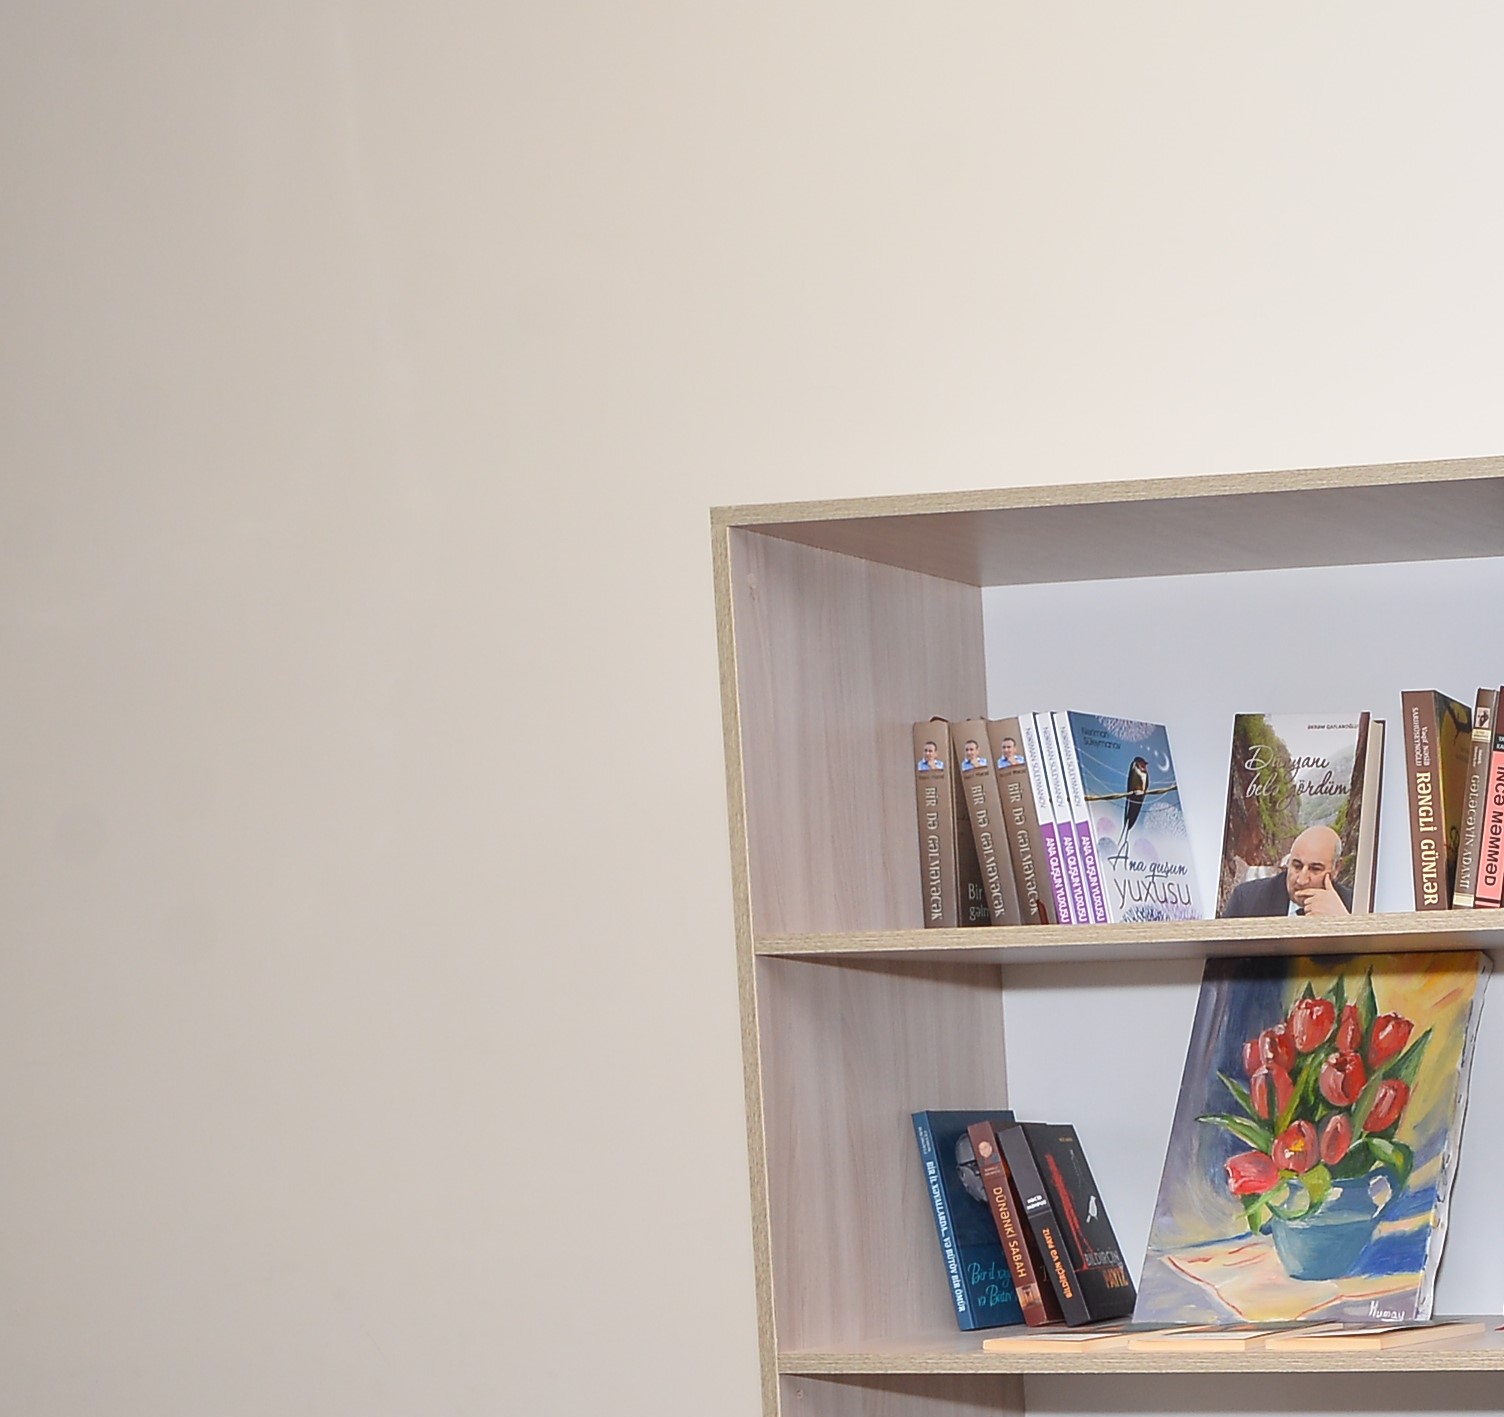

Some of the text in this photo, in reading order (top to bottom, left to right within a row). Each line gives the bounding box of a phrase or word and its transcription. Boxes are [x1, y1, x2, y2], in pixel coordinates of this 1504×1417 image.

[925, 787, 937, 807] BİR
[925, 813, 938, 830] DƏ
[1081, 836, 1092, 856] ANA
[1416, 772, 1439, 906] RƏNGLİ GÜNLƏR
[1485, 811, 1504, 886] MƏMMƏD
[1108, 841, 1146, 872] Ana
[926, 834, 943, 921] GƏLMƏYƏCƏK
[1009, 1241, 1027, 1278] SABAH
[1369, 1300, 1405, 1322] Humay
